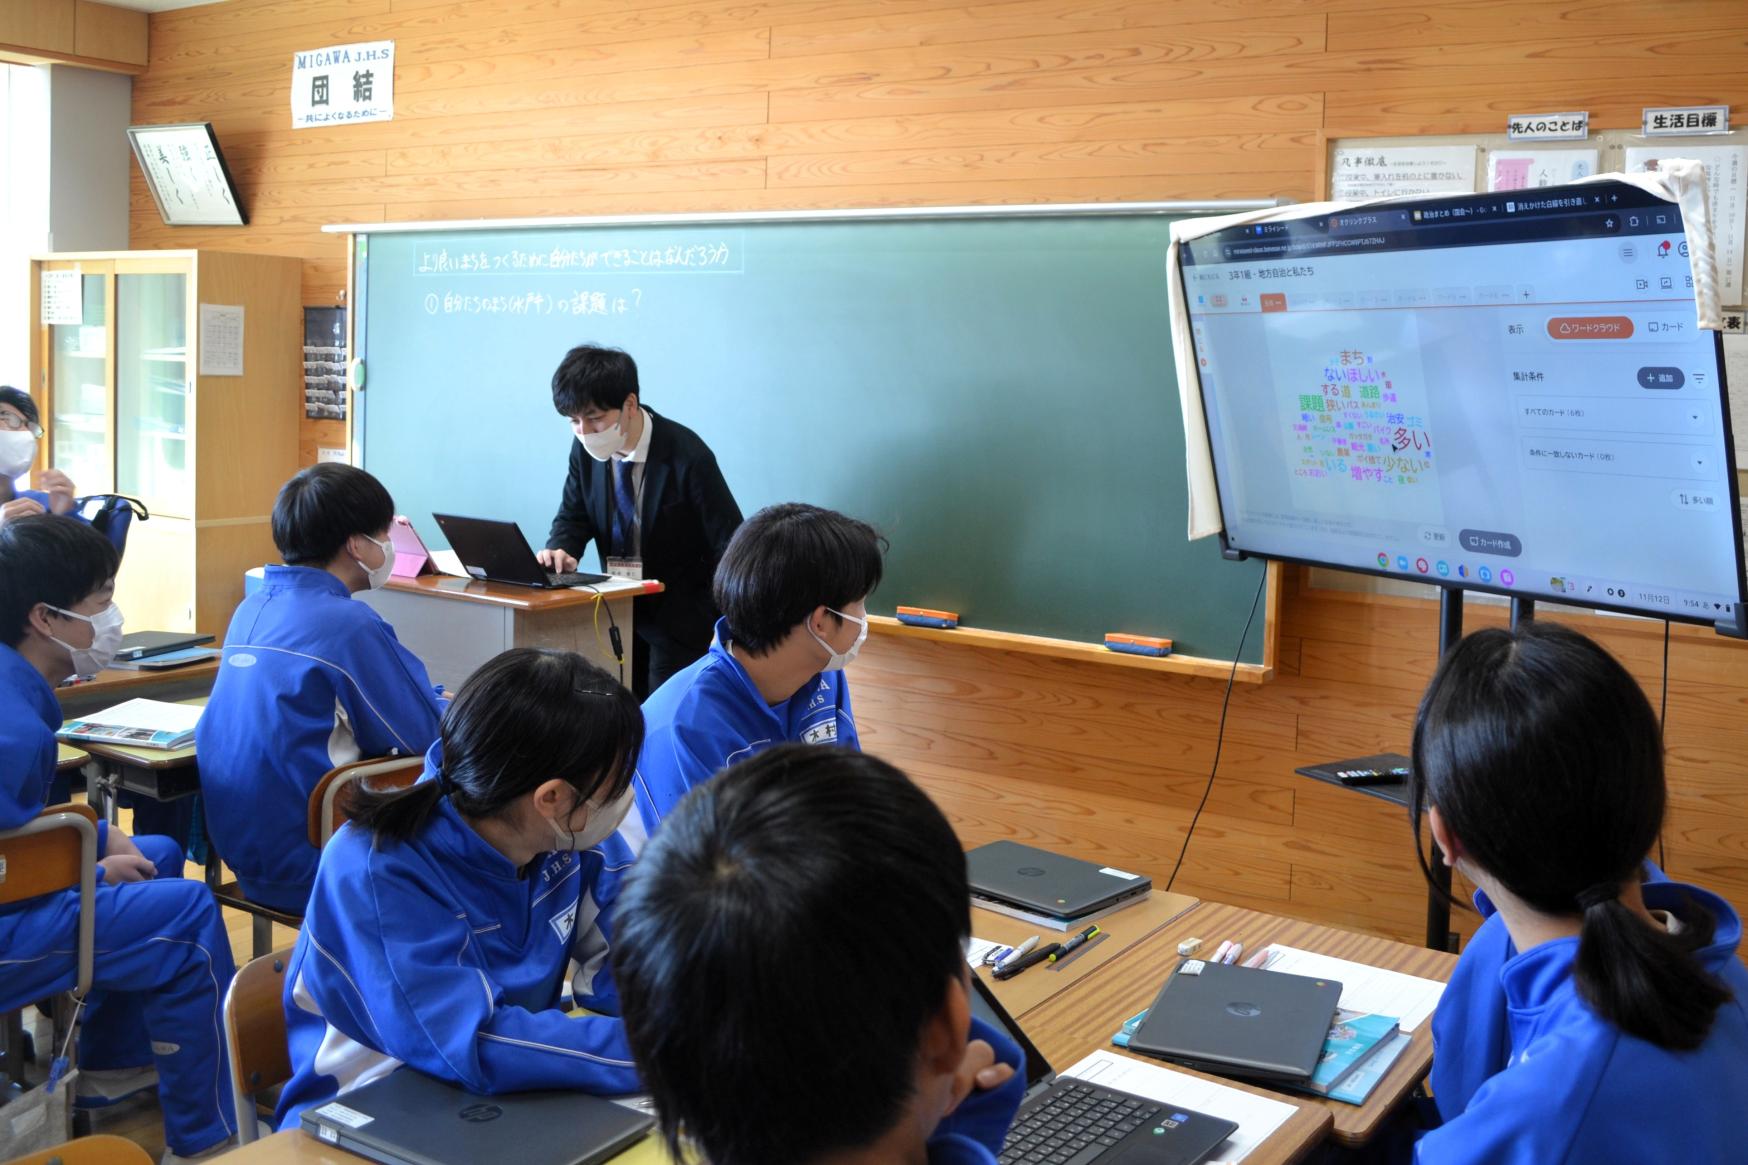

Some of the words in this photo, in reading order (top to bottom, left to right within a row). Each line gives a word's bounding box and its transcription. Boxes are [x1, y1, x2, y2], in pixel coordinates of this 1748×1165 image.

[297, 50, 350, 69] MIGAWA
[354, 49, 389, 62] J.H.S
[1511, 118, 1583, 134] 先人のことば
[1653, 112, 1717, 129] 生活目標
[1508, 324, 1524, 334] 表示
[1572, 323, 1621, 333] ワードクラウド
[1661, 322, 1684, 332] カード
[1340, 349, 1364, 366] まち
[1513, 371, 1545, 381] 集計条件
[1321, 384, 1339, 396] する
[1299, 394, 1325, 412] 課題
[1407, 416, 1424, 427] ゴミ
[1394, 427, 1431, 451] 多い
[1326, 459, 1347, 473] いる
[1384, 456, 1424, 473] 少ない
[1640, 593, 1670, 605] 11月12日
